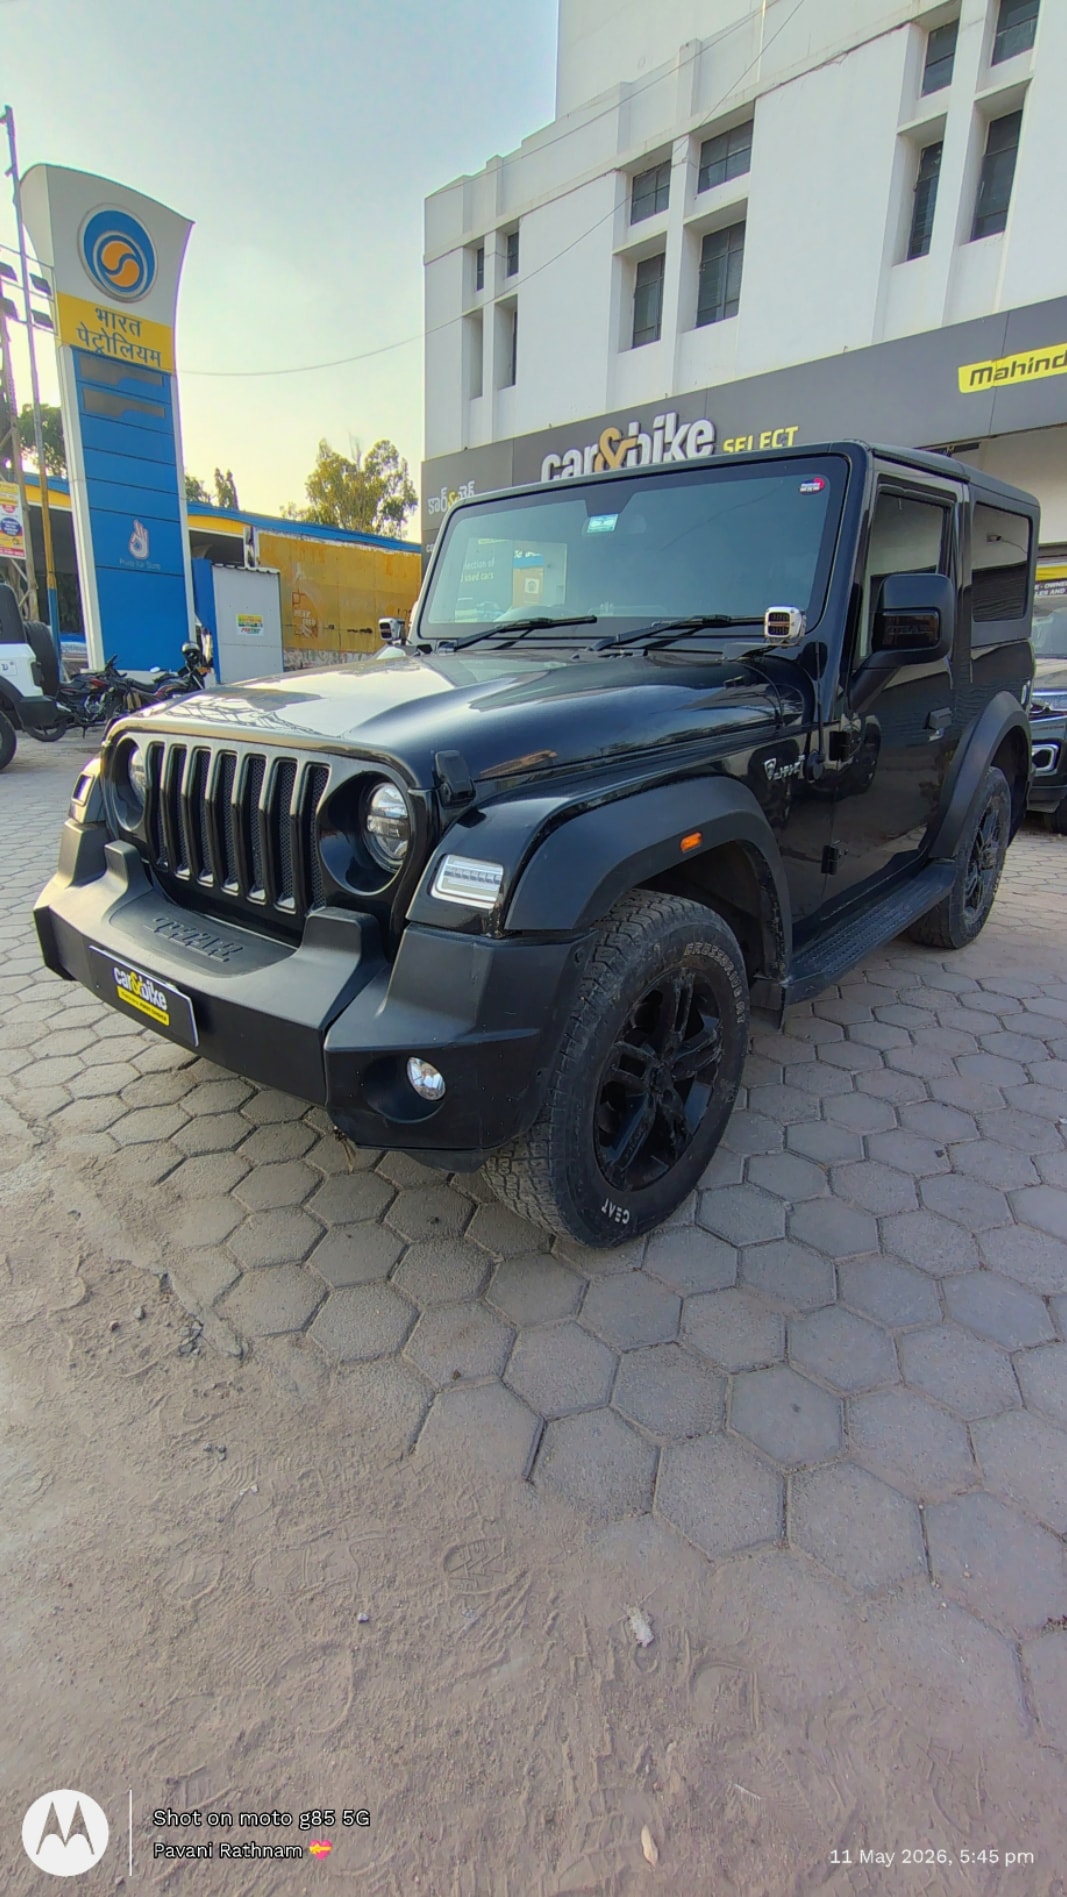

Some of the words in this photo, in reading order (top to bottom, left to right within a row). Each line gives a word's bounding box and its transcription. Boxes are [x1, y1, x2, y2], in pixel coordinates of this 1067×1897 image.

[95, 307, 142, 337] भारत
[75, 321, 162, 369] पेट्रोलियम
[969, 350, 1067, 386] Mahind
[541, 411, 716, 482] car&bike
[722, 426, 799, 453] SELECT
[113, 967, 168, 1011] car&bike
[601, 1198, 630, 1224] CEAT
